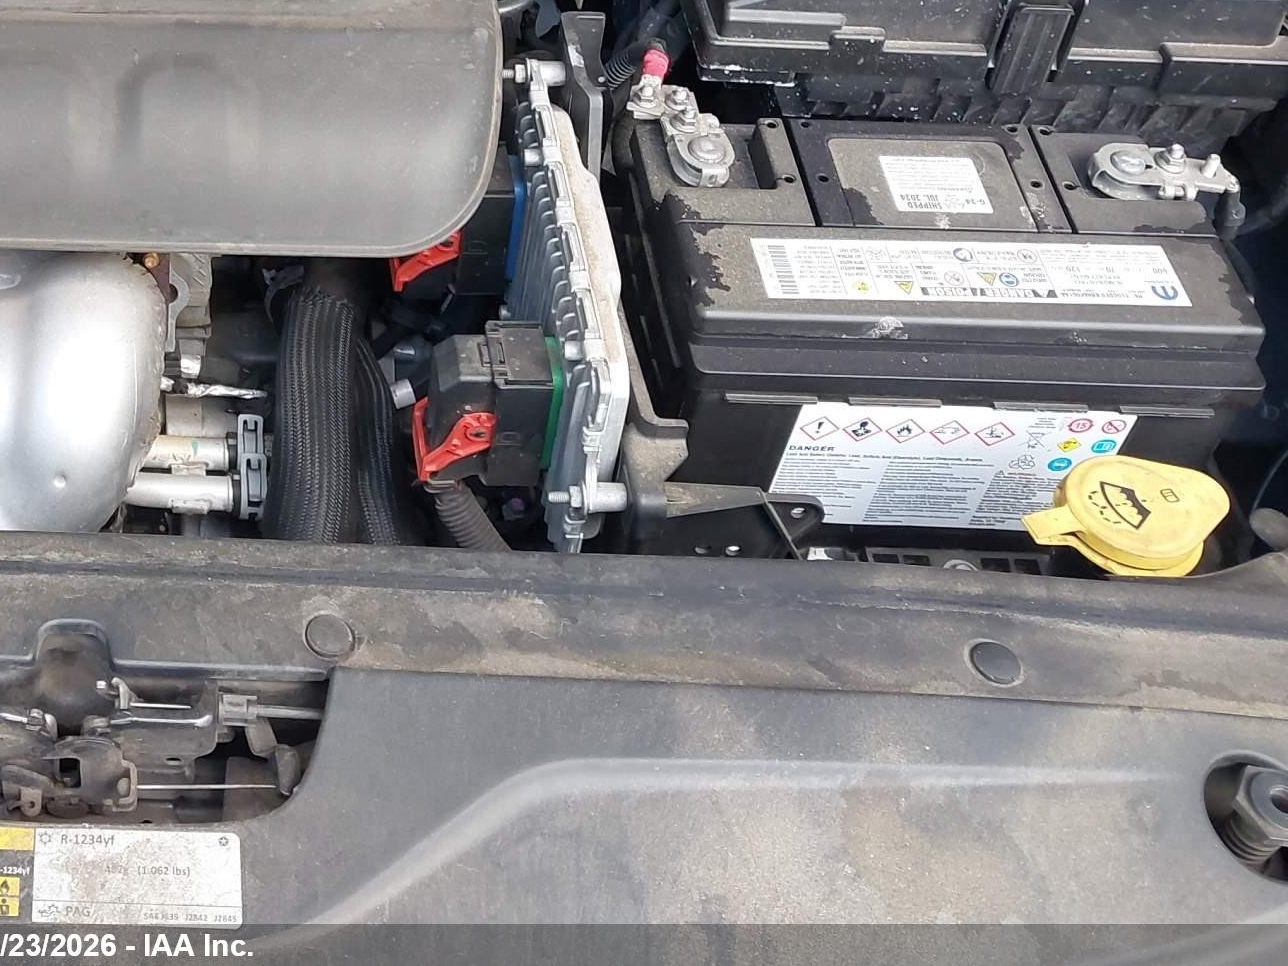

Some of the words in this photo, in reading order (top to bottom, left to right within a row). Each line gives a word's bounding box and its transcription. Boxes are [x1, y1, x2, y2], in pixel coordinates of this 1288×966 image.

[907, 202, 943, 210] SHIPPED
[927, 287, 972, 297] POISON
[985, 288, 1033, 298] DANGER
[61, 834, 115, 846] R-1234yf
[172, 866, 191, 877] lbs)
[66, 906, 91, 917] PAG
